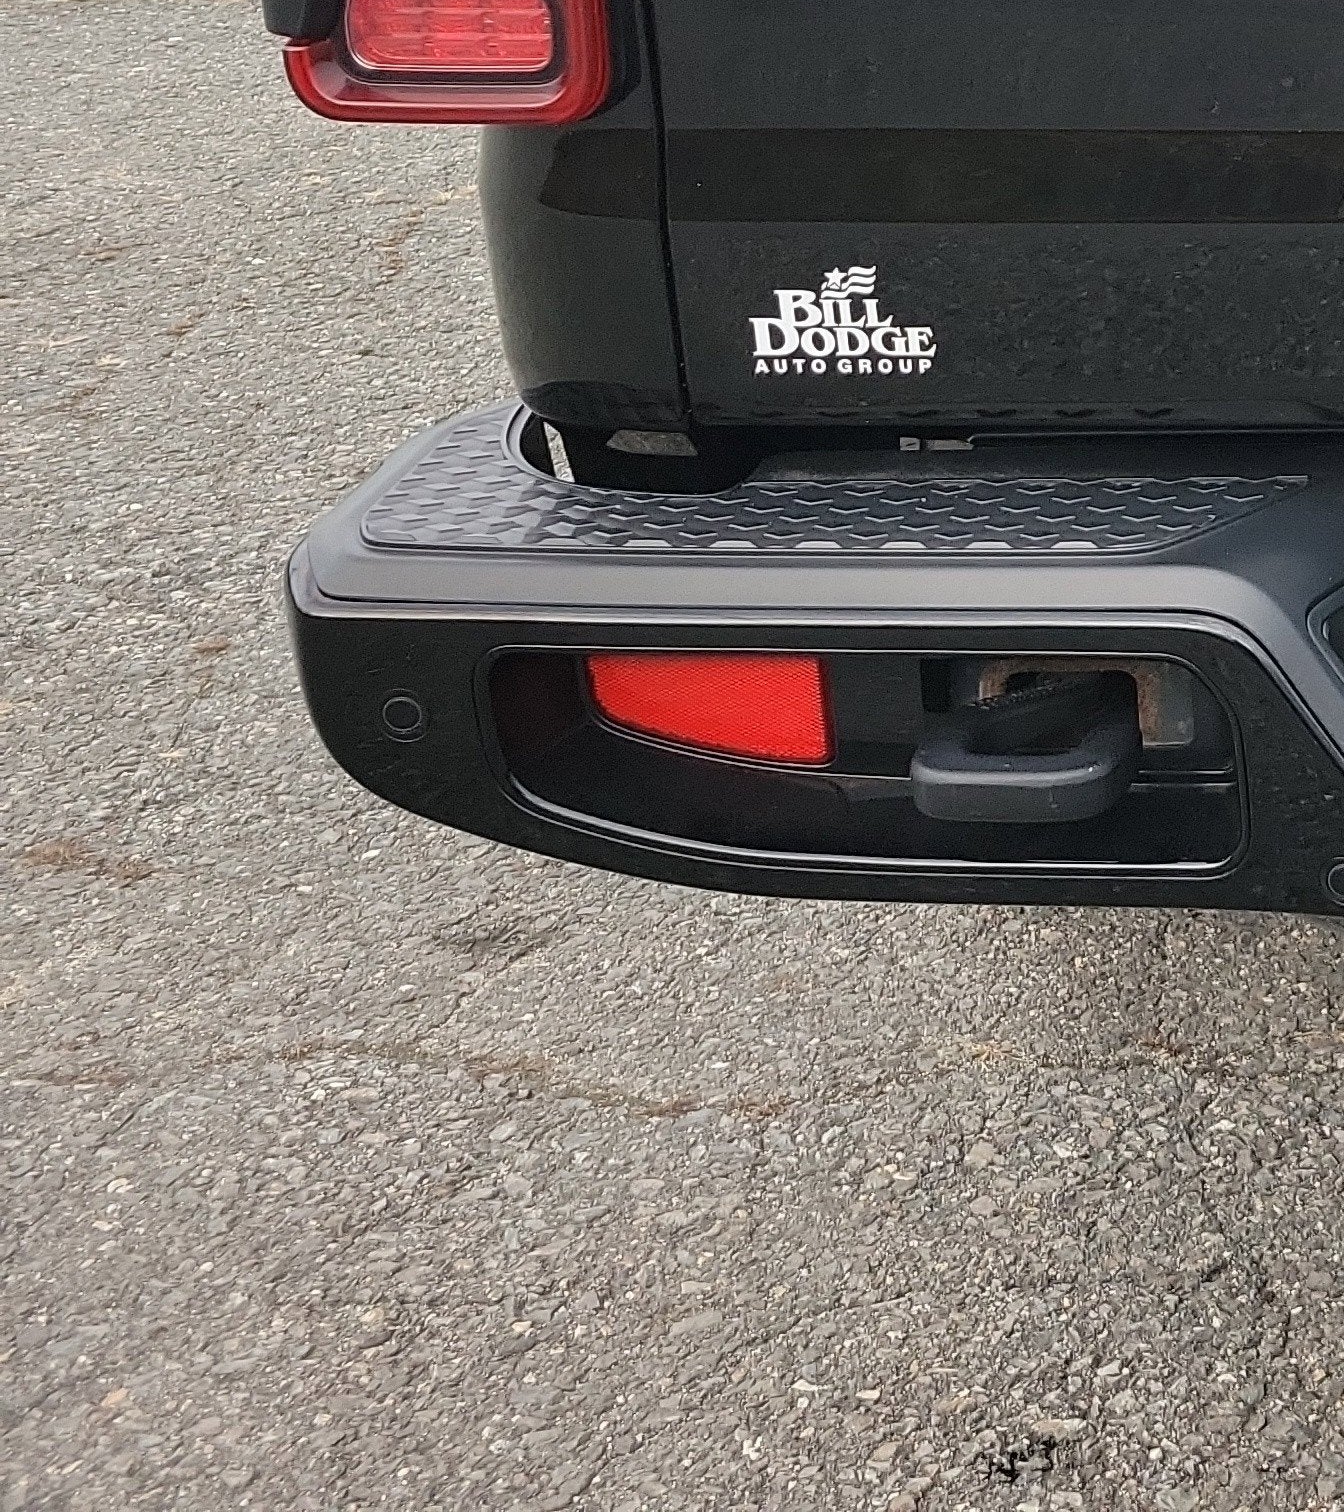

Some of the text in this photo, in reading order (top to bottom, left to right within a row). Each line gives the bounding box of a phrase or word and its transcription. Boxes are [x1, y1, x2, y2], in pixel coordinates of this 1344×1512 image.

[773, 289, 894, 328] BILL
[748, 317, 937, 357] DODGE
[754, 358, 933, 375] AUTO GROUP
